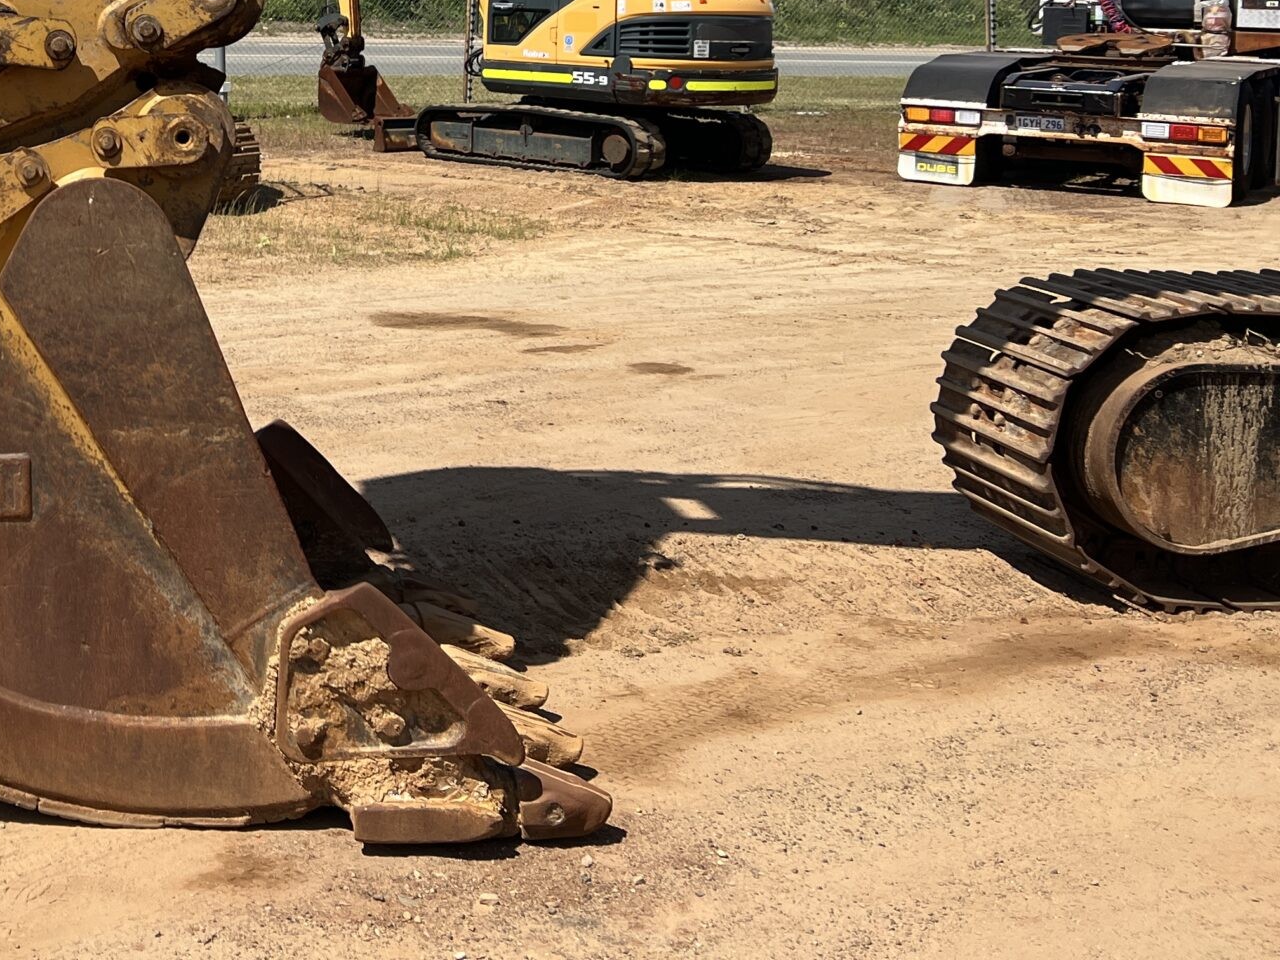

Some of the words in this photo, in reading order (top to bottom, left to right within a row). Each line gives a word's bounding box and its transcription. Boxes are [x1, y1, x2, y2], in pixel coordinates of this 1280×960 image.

[572, 71, 608, 86] 55-9
[1045, 119, 1062, 129] 296
[916, 162, 957, 174] QUBE
